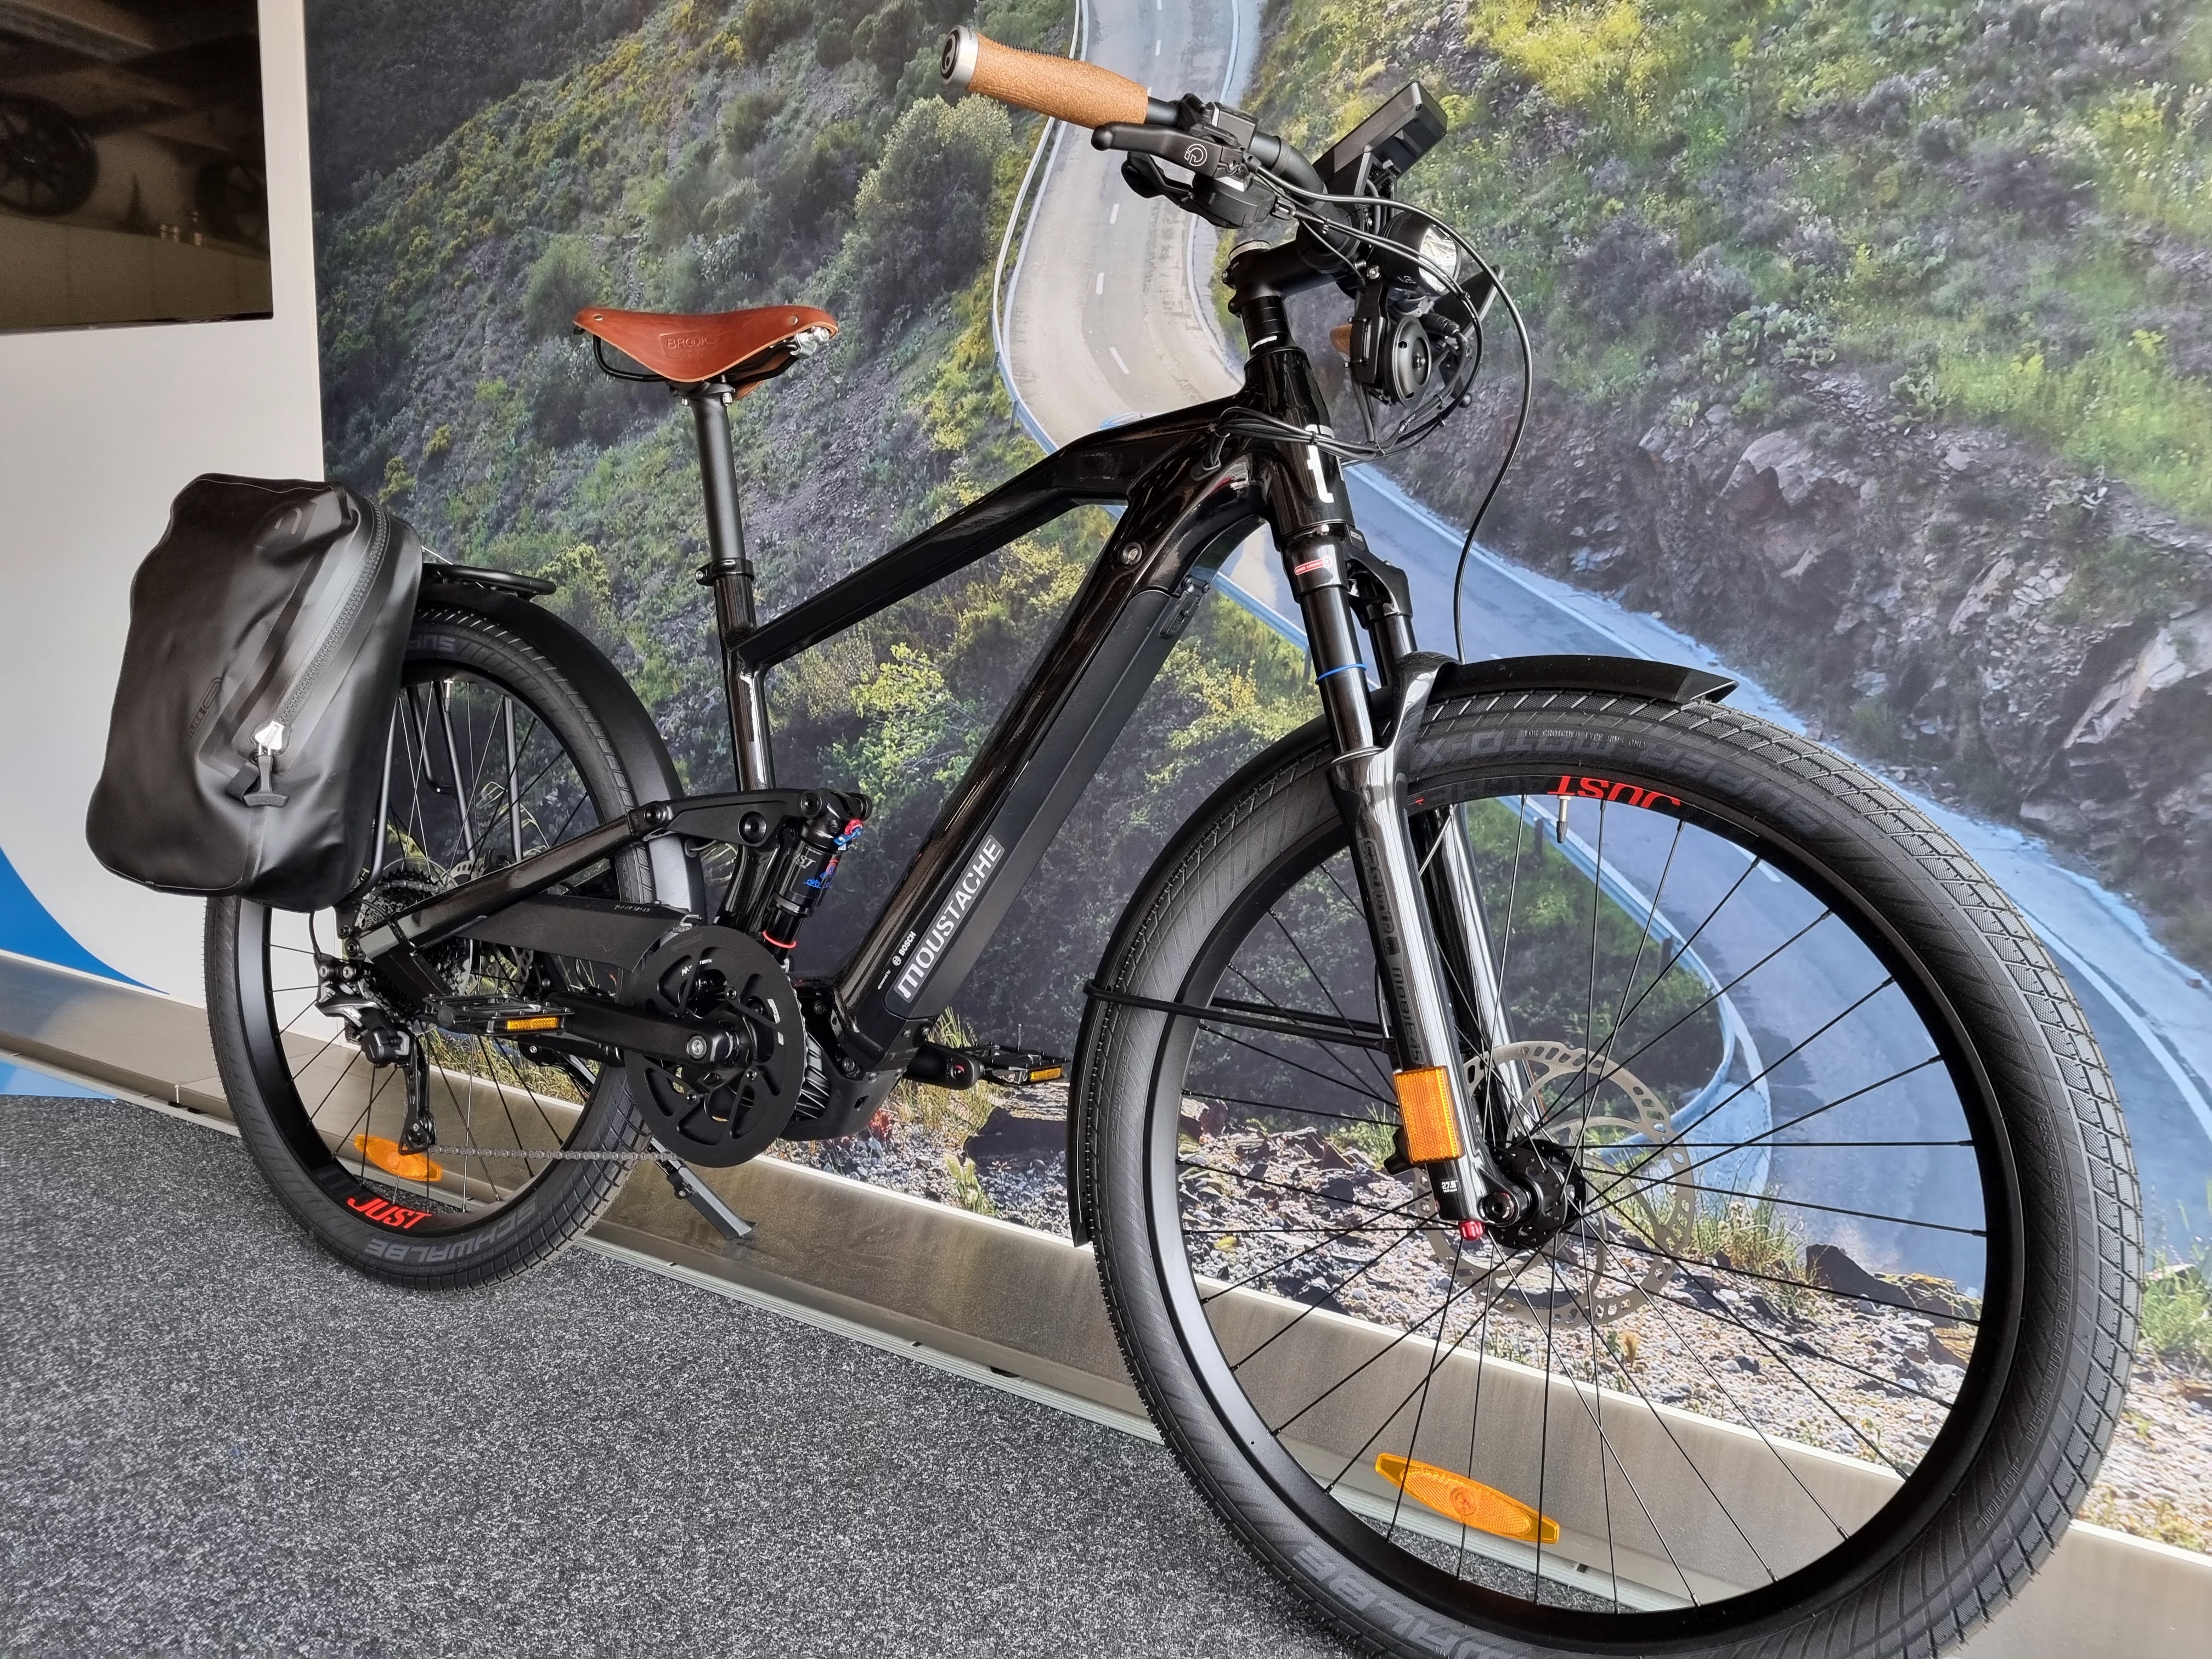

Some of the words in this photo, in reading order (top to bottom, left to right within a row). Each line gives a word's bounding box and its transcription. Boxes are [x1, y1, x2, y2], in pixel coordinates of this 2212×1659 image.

[897, 838, 1002, 1000] MOUSTACHE
[898, 930, 917, 956] BOSCH
[347, 1196, 433, 1229] JUST
[364, 1201, 537, 1263] SCHWALBE
